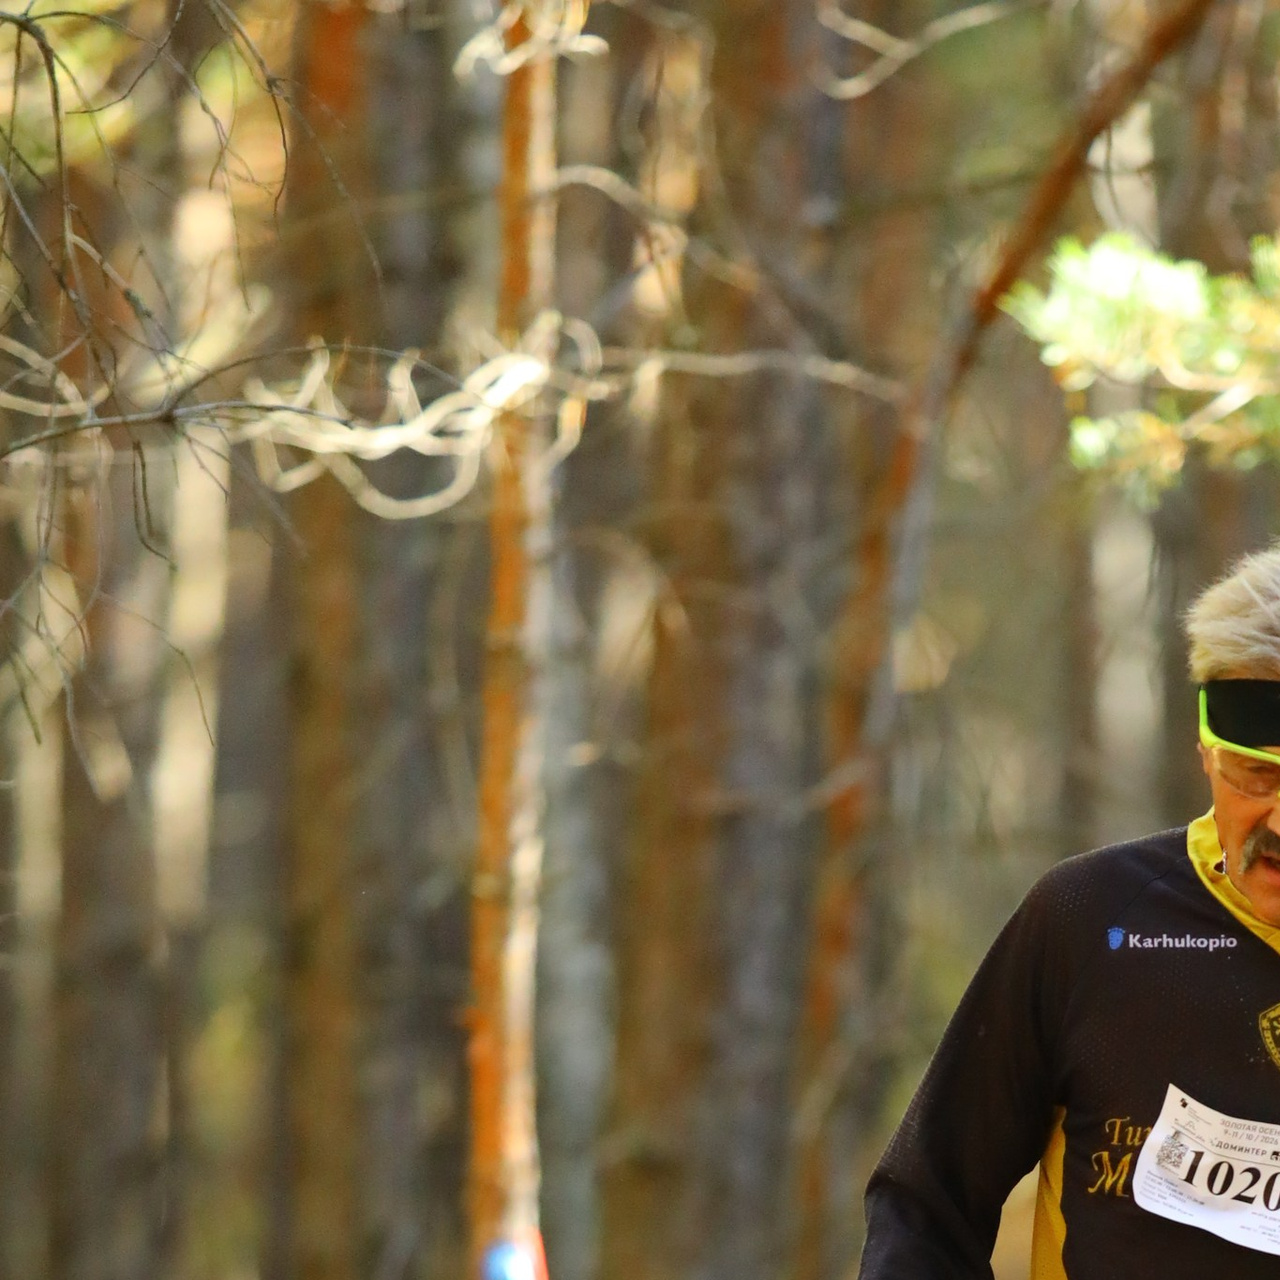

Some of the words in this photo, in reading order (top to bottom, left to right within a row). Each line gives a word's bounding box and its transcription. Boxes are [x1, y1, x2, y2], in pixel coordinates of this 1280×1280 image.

[1128, 933, 1238, 952] Karhukopio
[1219, 1118, 1258, 1132] ЗОЛОТАЯ
[1215, 1140, 1268, 1157] ДОМИНТЕР
[1087, 1151, 1134, 1198] M
